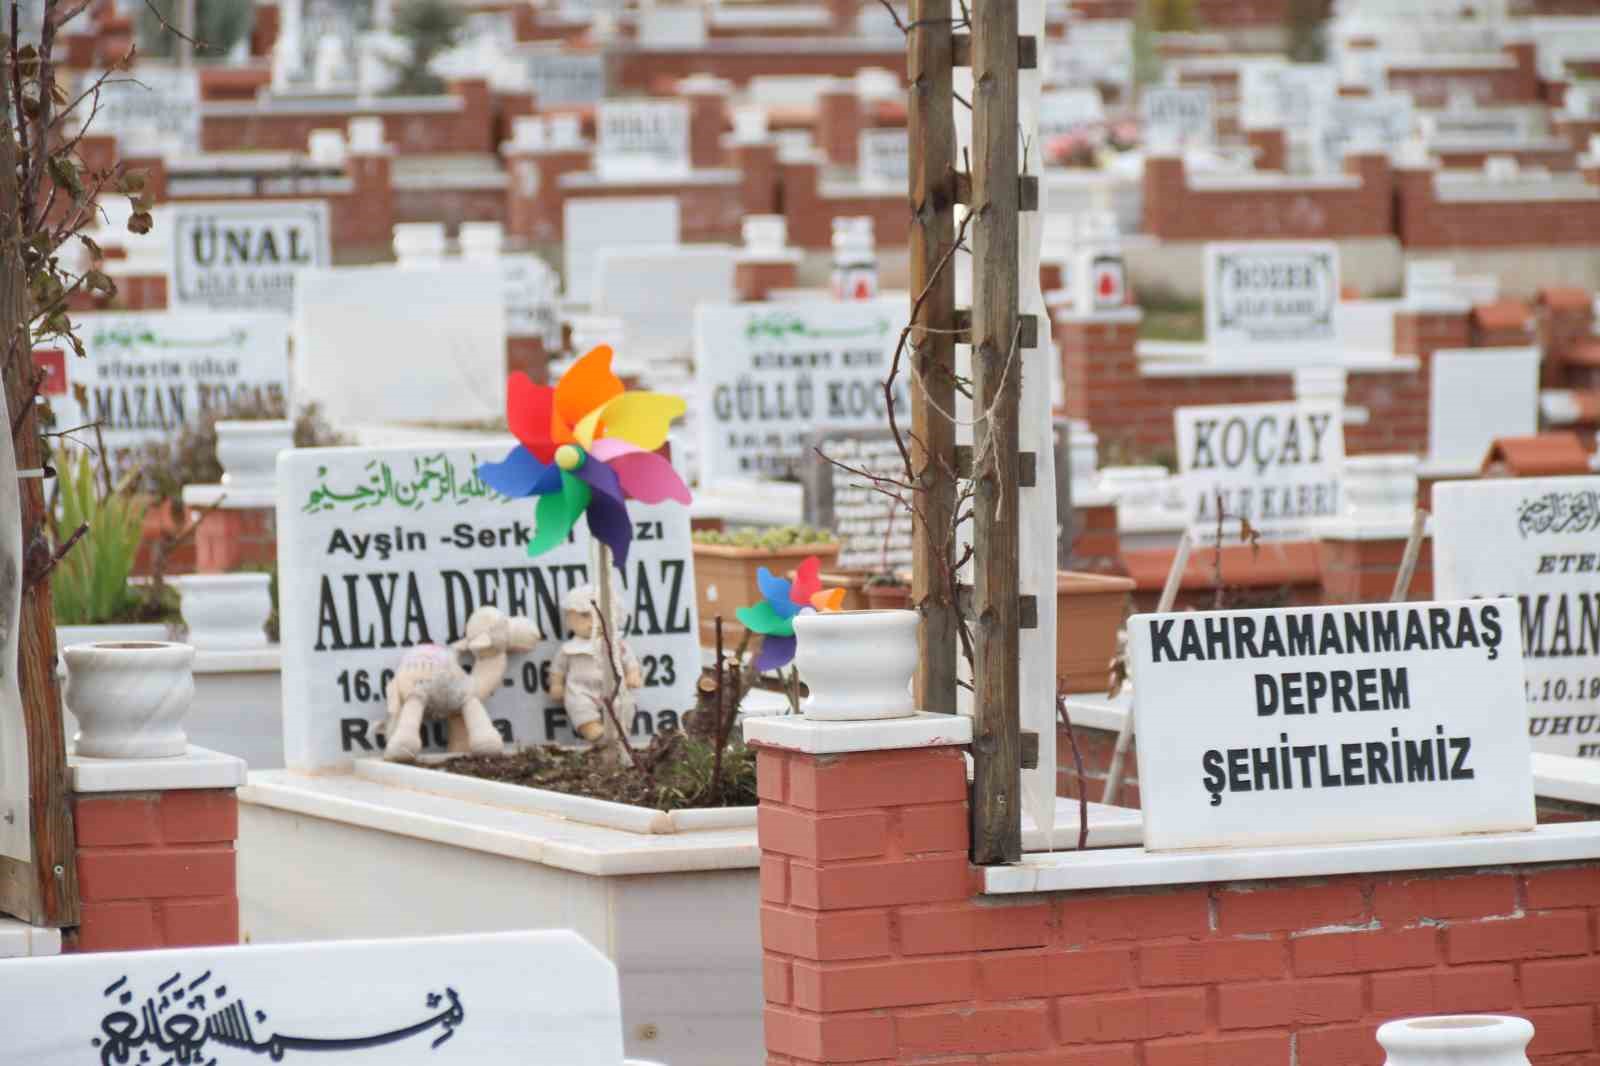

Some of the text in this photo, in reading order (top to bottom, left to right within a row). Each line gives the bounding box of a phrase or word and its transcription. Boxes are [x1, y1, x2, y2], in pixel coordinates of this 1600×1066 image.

[191, 213, 311, 266] ÜNAL
[713, 373, 913, 422] GÜLLÜ KOÇA
[1190, 413, 1332, 476] KOÇAY
[440, 521, 577, 550] -Serk
[1537, 554, 1600, 574] ETE
[314, 571, 433, 652] ALYA
[1150, 604, 1502, 663] KAHRAMANMARAŞ
[1254, 667, 1410, 716] DEPREM
[1202, 724, 1475, 806] ŞEHİTLERİMİZ
